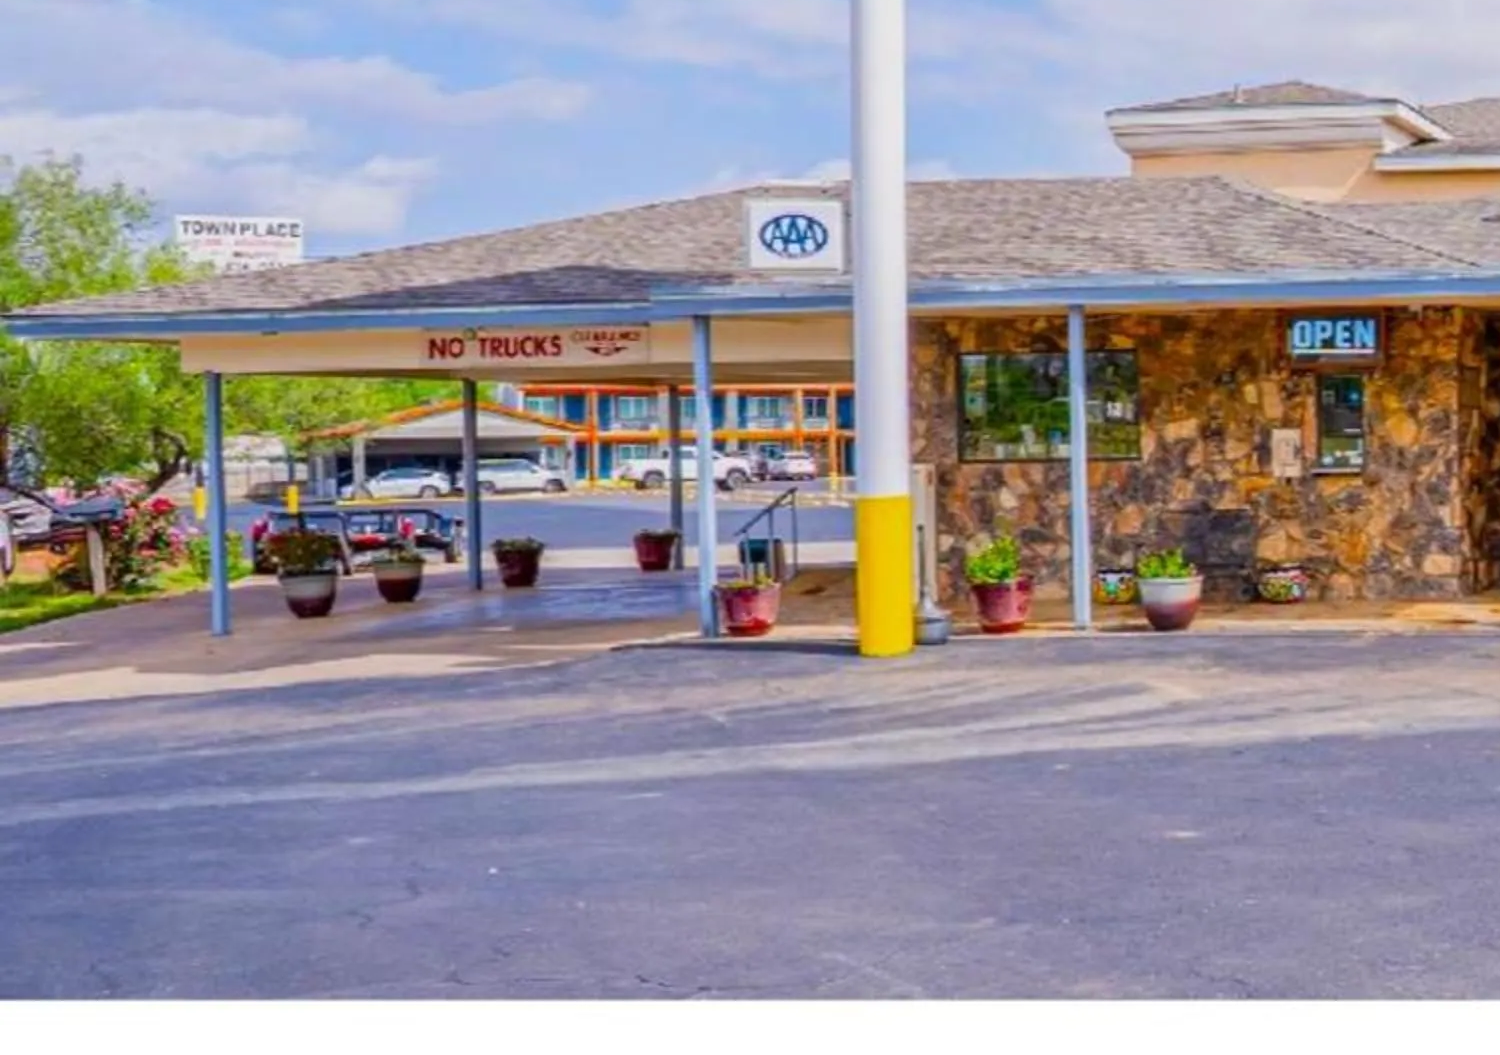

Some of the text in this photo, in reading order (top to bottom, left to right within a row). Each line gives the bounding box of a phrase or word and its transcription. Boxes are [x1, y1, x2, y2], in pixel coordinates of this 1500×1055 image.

[180, 219, 301, 239] TOWN PLACE
[766, 216, 823, 254] AAA
[428, 334, 563, 360] NO TRUCKS
[1292, 318, 1377, 349] OPEN
